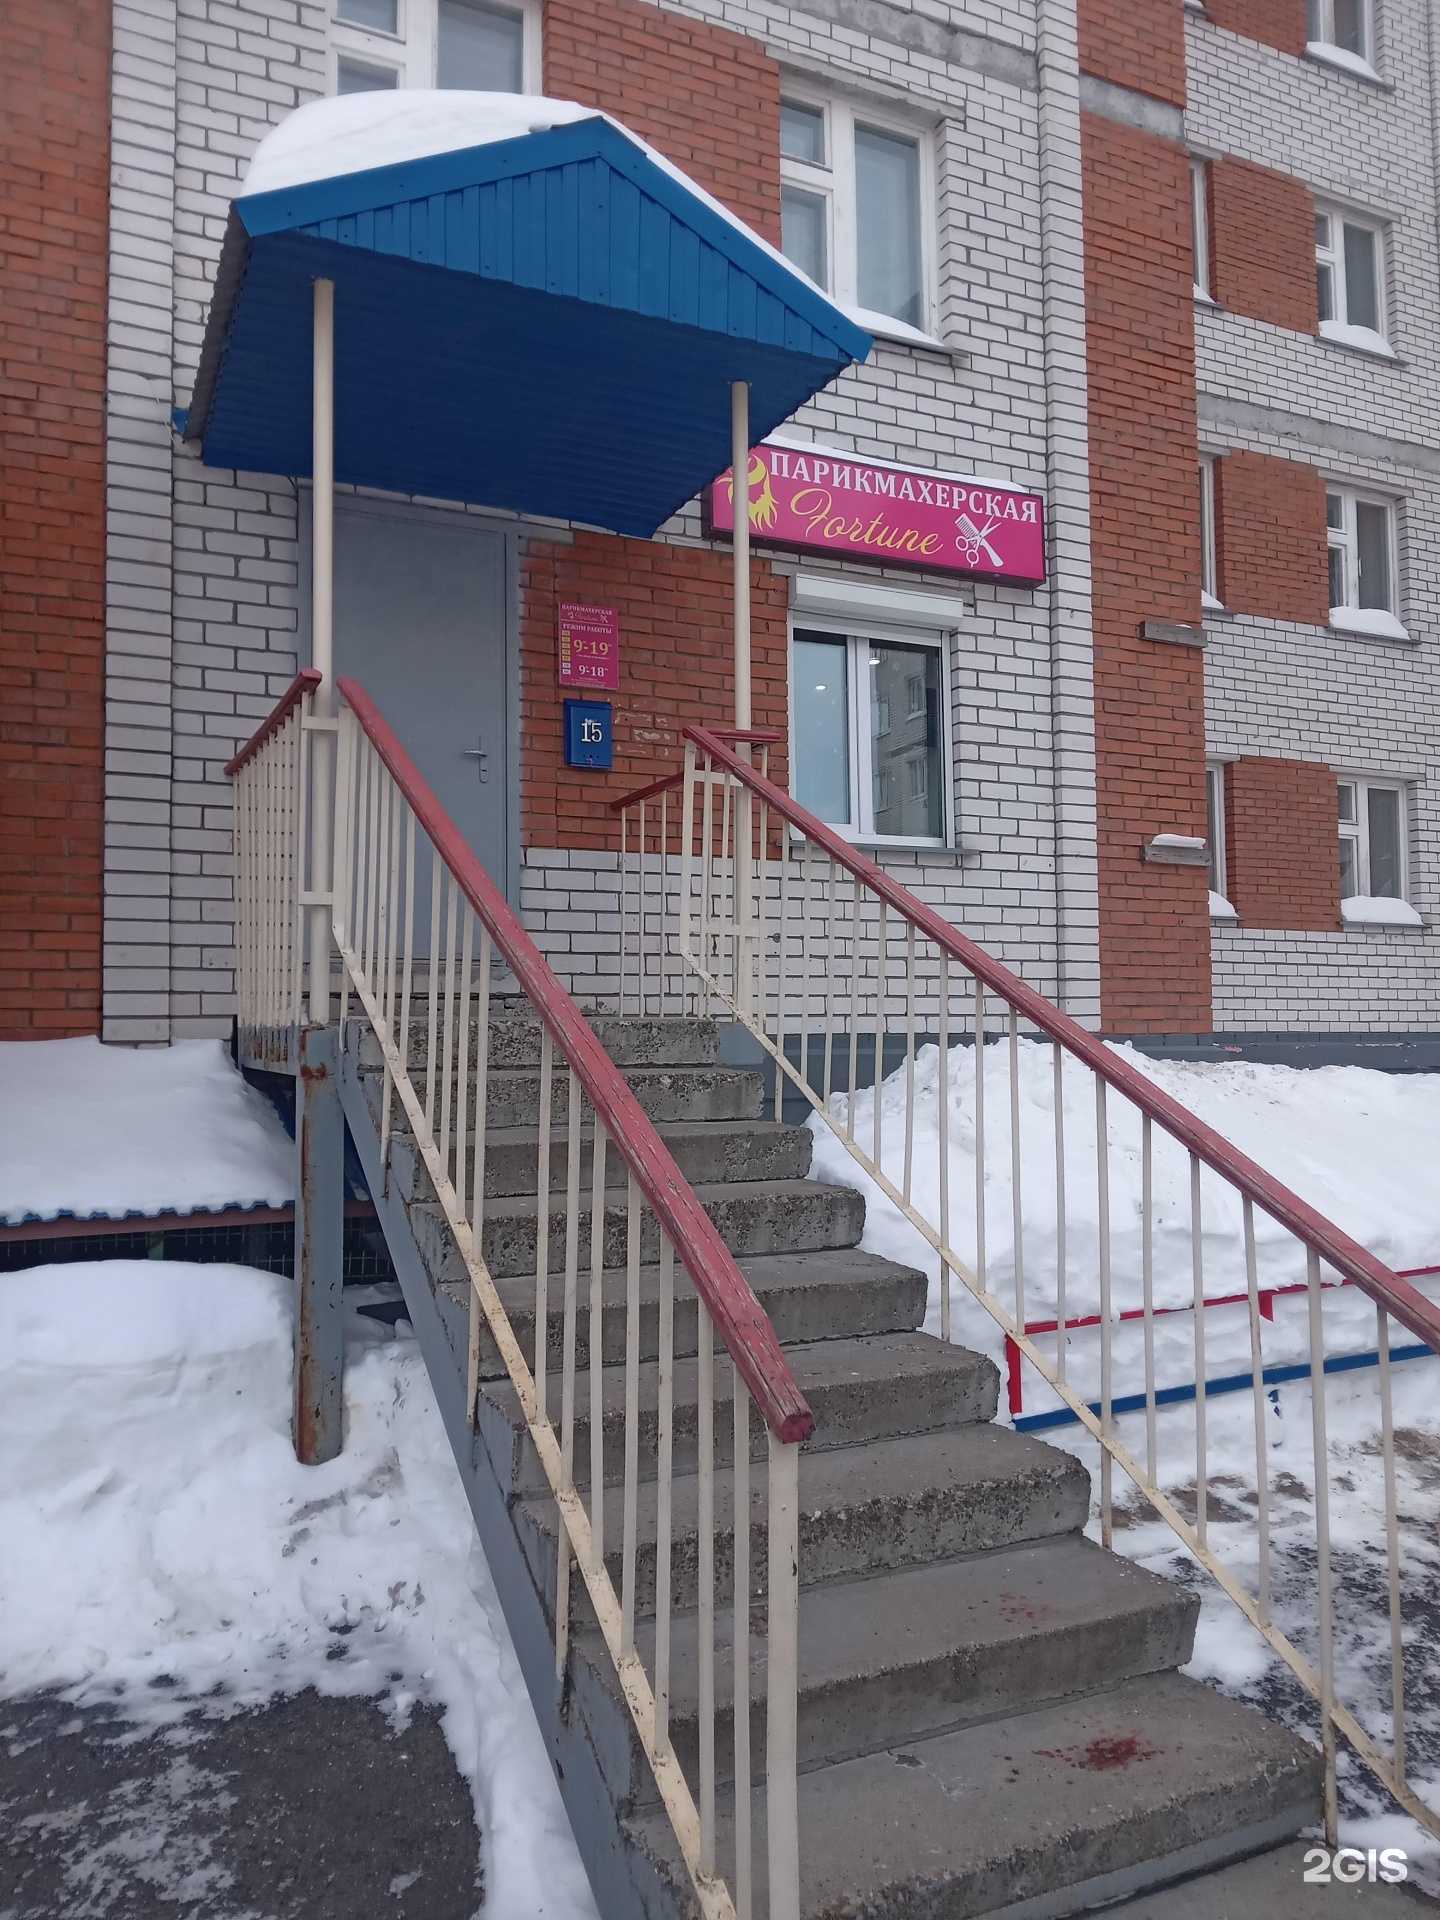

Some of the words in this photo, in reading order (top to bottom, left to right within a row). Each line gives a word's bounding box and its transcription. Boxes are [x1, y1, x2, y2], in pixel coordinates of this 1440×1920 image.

[770, 451, 1037, 524] ПАРИКМАХЕРСКАЯ
[790, 488, 944, 555] Fortune
[581, 722, 602, 742] 15
